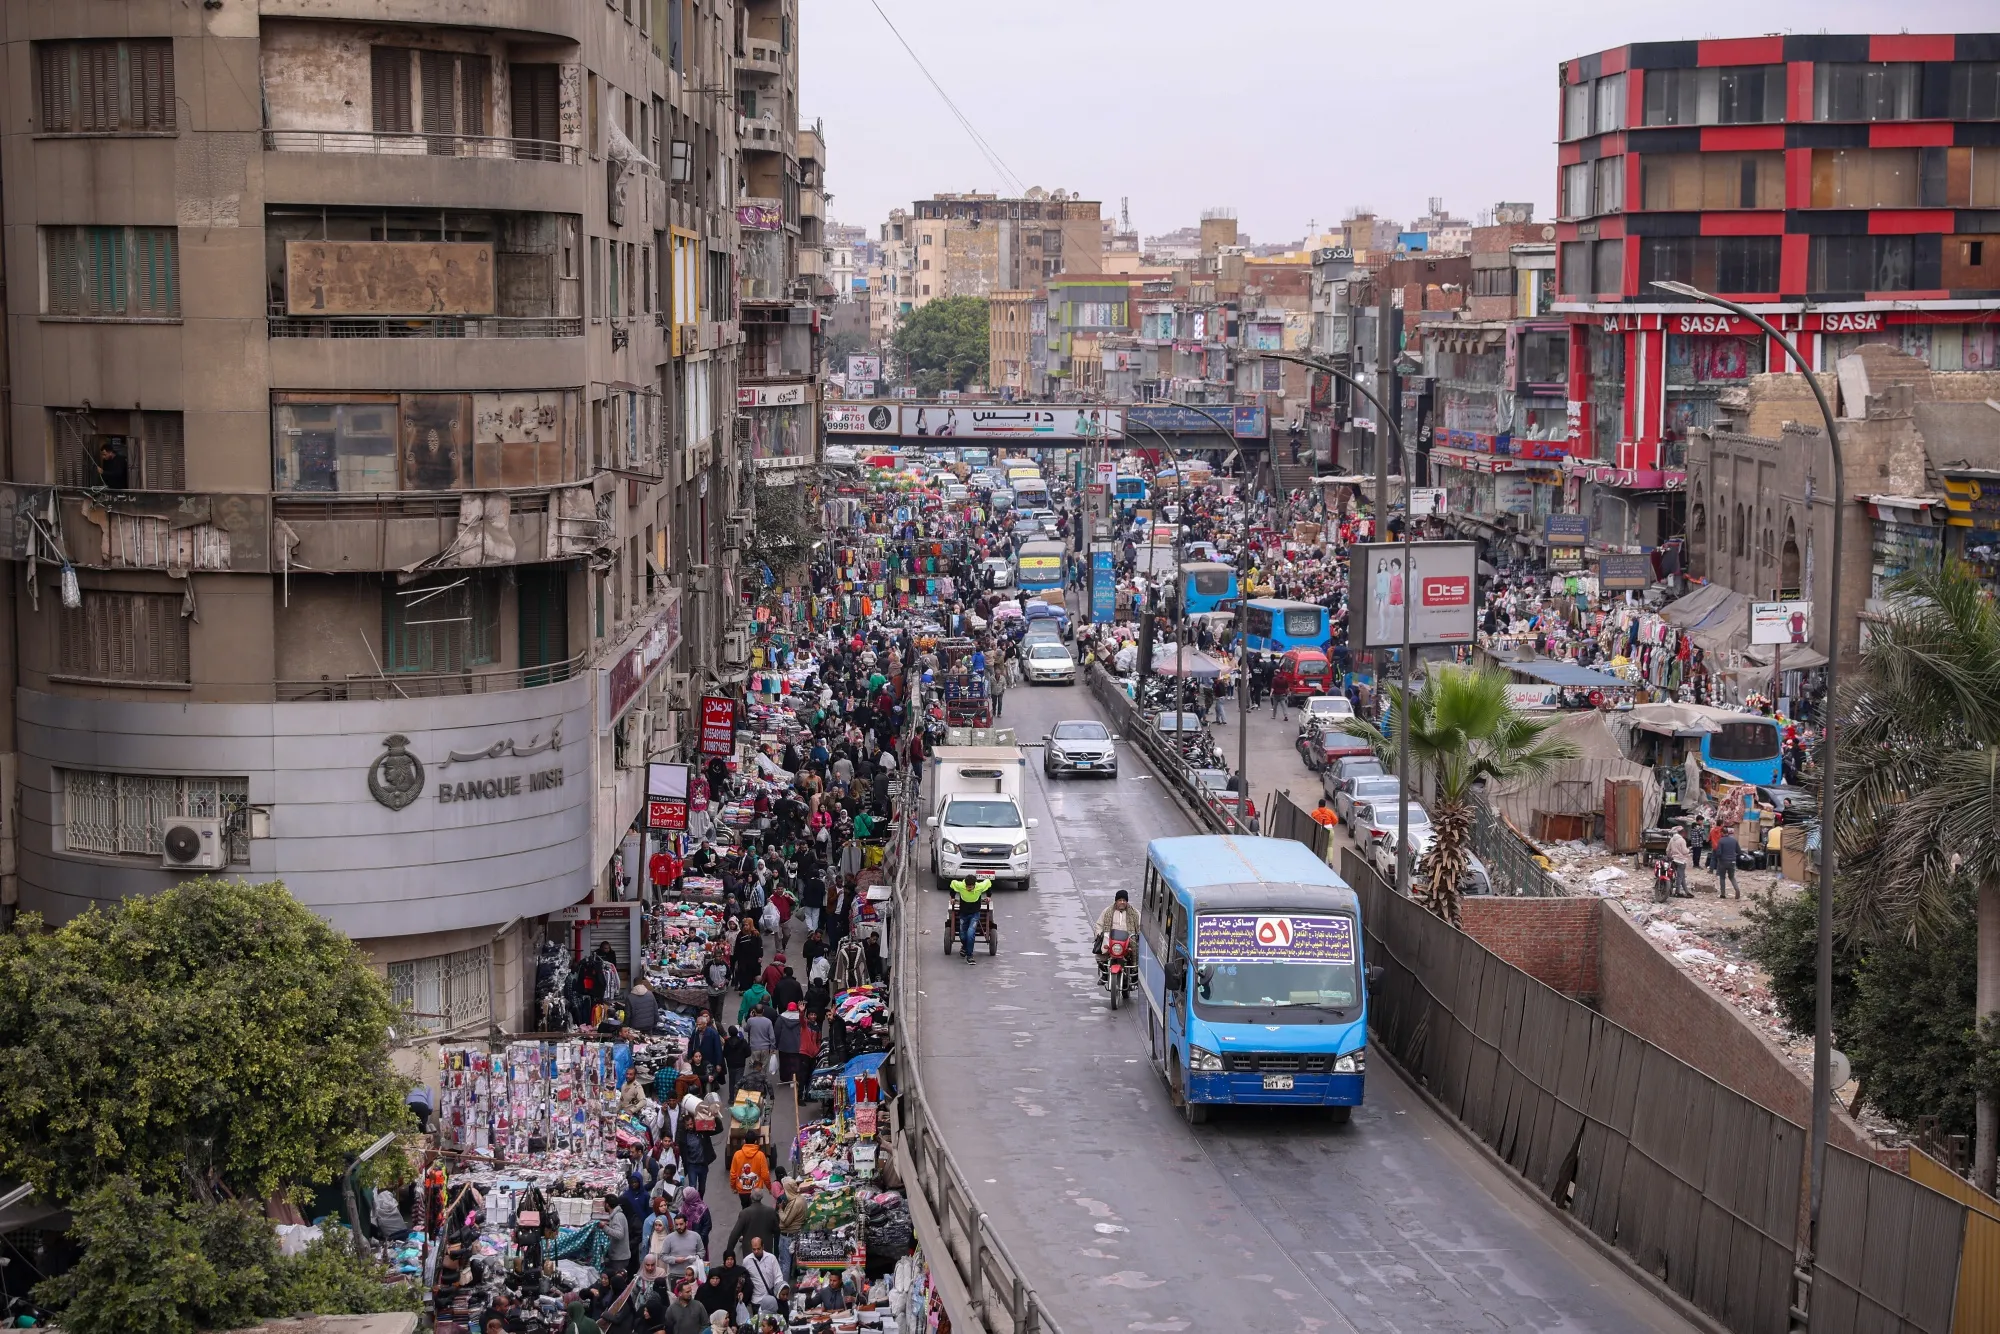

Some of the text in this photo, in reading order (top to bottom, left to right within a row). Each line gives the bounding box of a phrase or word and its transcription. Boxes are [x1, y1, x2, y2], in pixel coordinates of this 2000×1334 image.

[1680, 316, 1730, 333] SASA
[1825, 313, 1877, 331] SASA
[973, 411, 1054, 422] دايس
[1428, 583, 1465, 597] Ots
[705, 700, 732, 715] للإعلان
[706, 715, 730, 727] هنا
[438, 737, 515, 769] مصر
[439, 767, 564, 803] BANQUE MISR
[653, 805, 685, 818] للإعلان
[562, 906, 579, 914] ATM
[1199, 917, 1254, 928] مساكن عين شمس
[1259, 918, 1290, 945] ٥١
